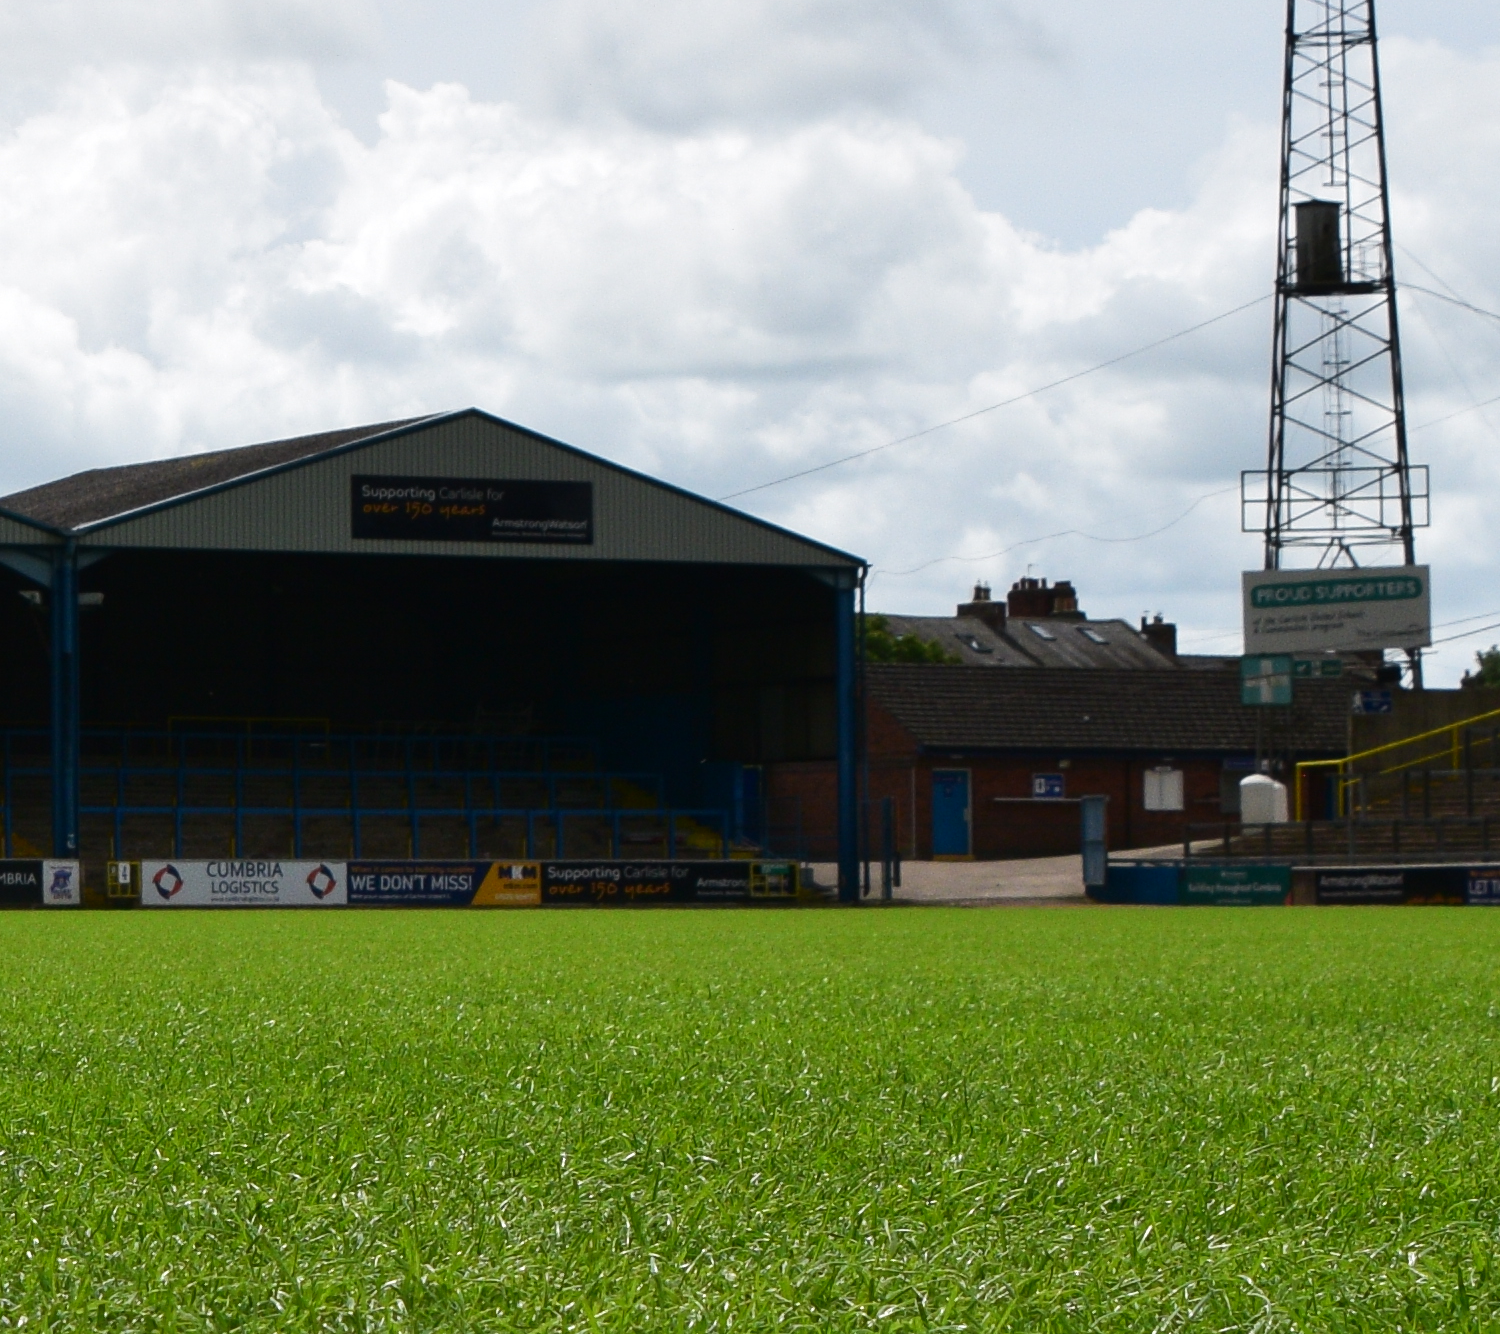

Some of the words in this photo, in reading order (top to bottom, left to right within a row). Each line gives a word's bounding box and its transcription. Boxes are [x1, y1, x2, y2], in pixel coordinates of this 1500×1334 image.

[361, 484, 437, 501] Supporting
[439, 486, 485, 501] Carlisle
[487, 487, 505, 501] for
[363, 501, 399, 514] over
[406, 499, 432, 519] 150
[440, 503, 486, 520] years
[1257, 586, 1312, 603] PROUD
[1315, 580, 1417, 599] SUPPORTERS
[206, 861, 284, 878] CUMBRIA
[498, 866, 537, 880] MKM
[547, 866, 621, 881] Supporting
[623, 866, 669, 879] Carlisle
[671, 866, 690, 879] for
[211, 880, 280, 895] LOGISTICS
[351, 875, 376, 891] WE
[380, 875, 427, 891] DON'T
[431, 875, 473, 891] MISS!
[549, 884, 584, 895] over
[590, 881, 618, 900] 150
[624, 882, 672, 900] years
[1468, 879, 1489, 895] LET
